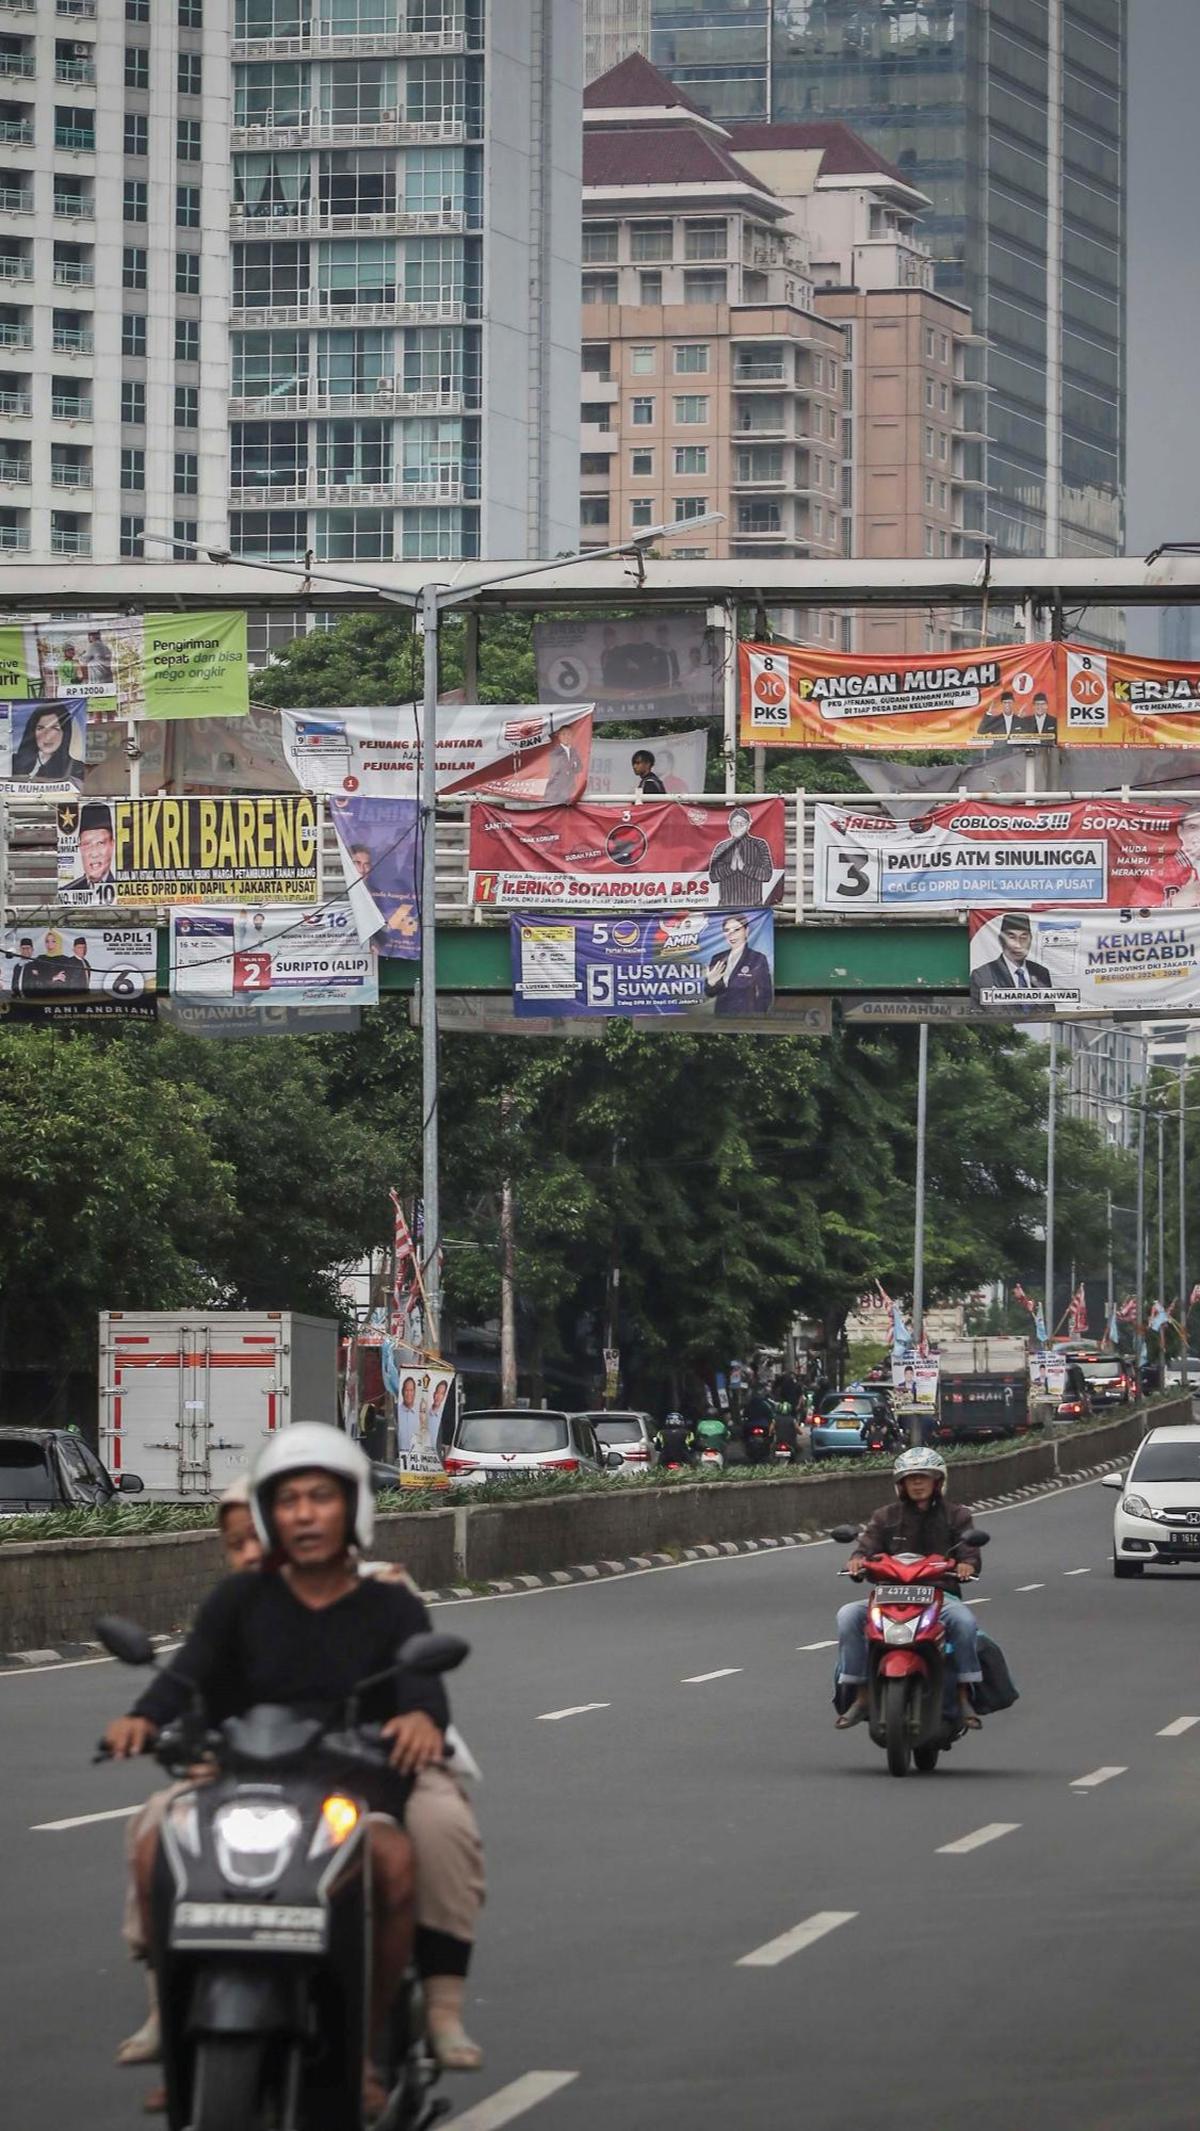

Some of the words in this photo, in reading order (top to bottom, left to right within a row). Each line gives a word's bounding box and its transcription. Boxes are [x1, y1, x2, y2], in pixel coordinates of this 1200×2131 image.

[153, 639, 220, 652] Pengiriman
[153, 654, 190, 668] cepat
[193, 653, 216, 664] dan
[218, 651, 243, 662] bisa
[764, 657, 774, 671] 8
[1082, 657, 1092, 670] 8
[154, 671, 185, 682] nego
[188, 666, 226, 681] ongkir
[799, 673, 897, 699] PANGAN
[903, 663, 997, 692] MURAH
[80, 686, 105, 695] 12000
[1114, 680, 1192, 701] KERJA
[754, 706, 788, 720] PKS
[1070, 707, 1106, 720] PKS
[297, 736, 304, 744] 9
[359, 740, 409, 749] PEJUANG
[363, 762, 413, 771] PEJUANG
[18, 784, 71, 793] MUHAMMAD
[621, 811, 631, 822] 3
[950, 817, 1009, 829] COBLOS
[116, 800, 190, 870] FIKRI
[200, 798, 315, 868] BARENO
[1121, 845, 1148, 853] MUDA
[887, 852, 952, 870] PAULUS
[955, 851, 990, 866] ATM
[994, 850, 1097, 866] SINULINGGA
[1117, 857, 1151, 865] MAMPU
[836, 853, 870, 897] 3
[1111, 869, 1155, 877] MERAKYAT
[117, 883, 149, 897] CALEG
[151, 883, 177, 895] DPRD
[180, 882, 197, 895] DKI
[200, 882, 227, 894] DAPIL
[230, 882, 236, 894] 1
[239, 881, 283, 894] JAKARTA
[285, 880, 316, 893] PUSAT
[480, 877, 492, 900] 1
[502, 880, 565, 896] Ir.ERIKO
[568, 881, 667, 898] SOTARDUGA
[671, 881, 710, 896] B.P.S
[887, 883, 927, 893] CALEG
[928, 880, 960, 891] DPRD
[962, 880, 998, 891] DAPIL
[1000, 880, 1052, 890] JAKARTA
[1056, 879, 1095, 889] PUSAT
[96, 885, 115, 905] 10
[327, 913, 348, 928] 16
[1120, 909, 1132, 923] 5
[103, 933, 142, 943] DAPIL
[145, 933, 152, 943] 1
[592, 923, 609, 944] 5
[1097, 929, 1185, 949] KEMBALI
[663, 934, 699, 948] AMIN
[1088, 944, 1196, 966] MENGABDI
[276, 961, 329, 972] SURIPTO
[332, 960, 369, 972] (ALIP)
[617, 964, 700, 980] LUSYANI
[1163, 961, 1198, 969] JAKARTA
[112, 969, 135, 995] 6
[243, 963, 260, 987] 2
[592, 970, 610, 1001] 5
[617, 982, 701, 996] SUWANDI
[1044, 991, 1078, 999] ANWAR
[44, 1006, 78, 1014] RANI
[86, 1006, 155, 1016] ANDRIANI
